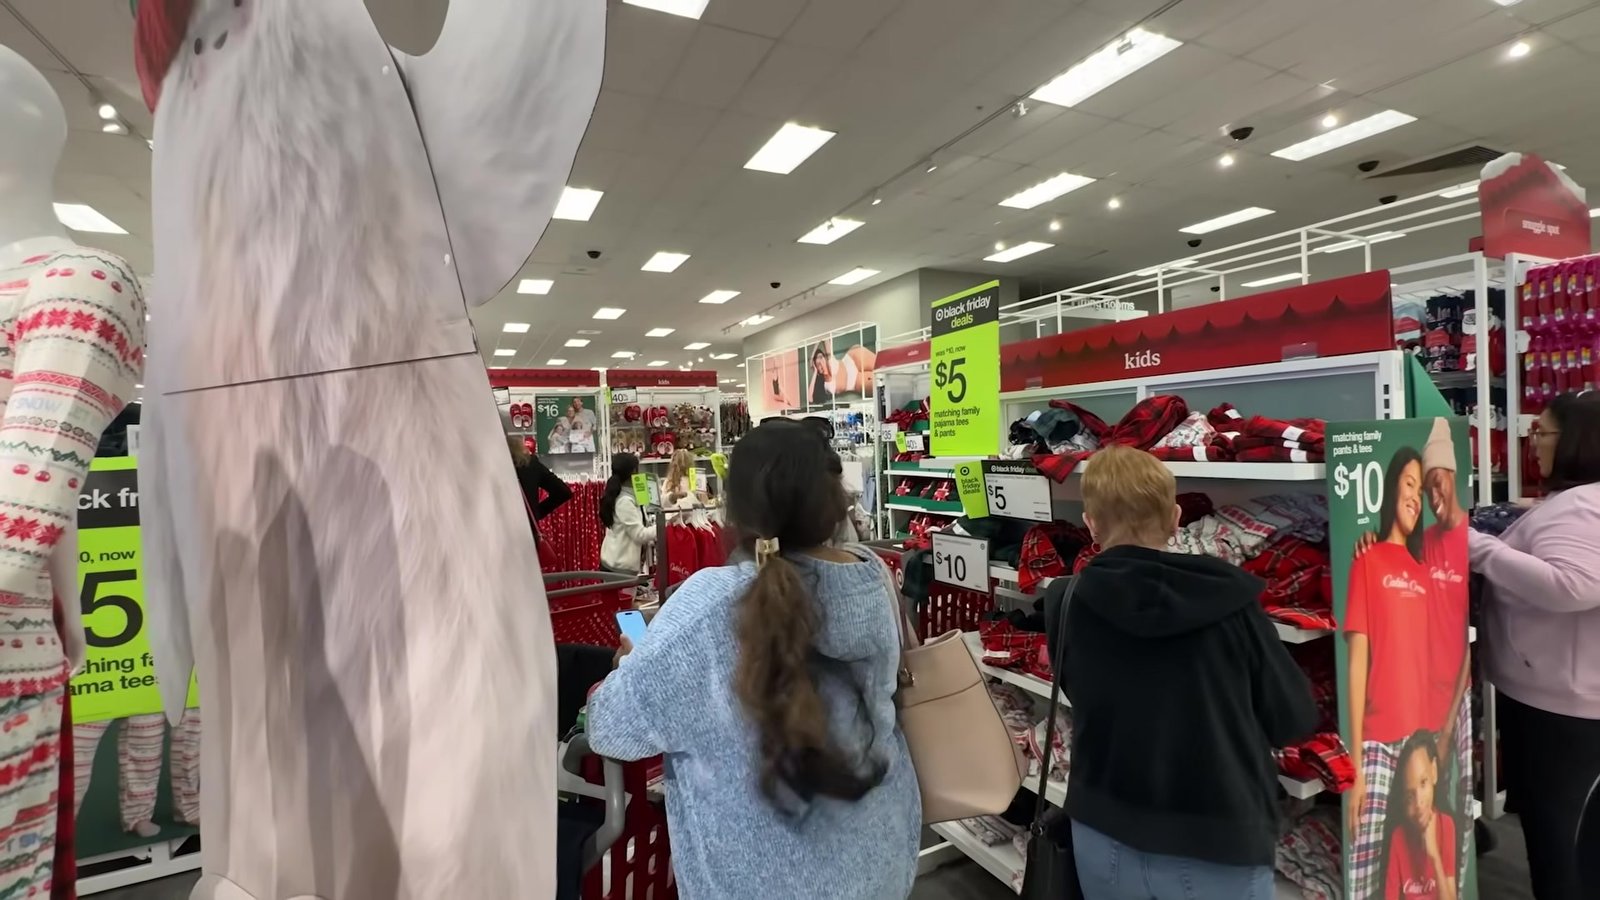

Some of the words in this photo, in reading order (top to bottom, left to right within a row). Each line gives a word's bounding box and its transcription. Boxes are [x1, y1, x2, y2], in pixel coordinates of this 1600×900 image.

[944, 302, 965, 318] black
[966, 295, 991, 312] friday
[951, 313, 973, 328] deals
[1124, 349, 1161, 369] kids
[935, 357, 966, 403] $5
[537, 404, 559, 417] $16
[934, 408, 960, 418] matching
[961, 405, 980, 416] family
[934, 420, 955, 429] pajama
[956, 418, 969, 426] tees
[939, 429, 956, 438] pants
[1332, 432, 1362, 443] matching
[1363, 430, 1382, 442] family
[1333, 445, 1352, 457] pants
[1352, 443, 1359, 454] &
[1359, 444, 1373, 454] tees
[1010, 466, 1024, 474] friday
[1334, 461, 1384, 515] $10
[988, 485, 1007, 510] $5
[99, 550, 136, 562] now
[935, 551, 967, 582] $10
[120, 674, 158, 690] tee
